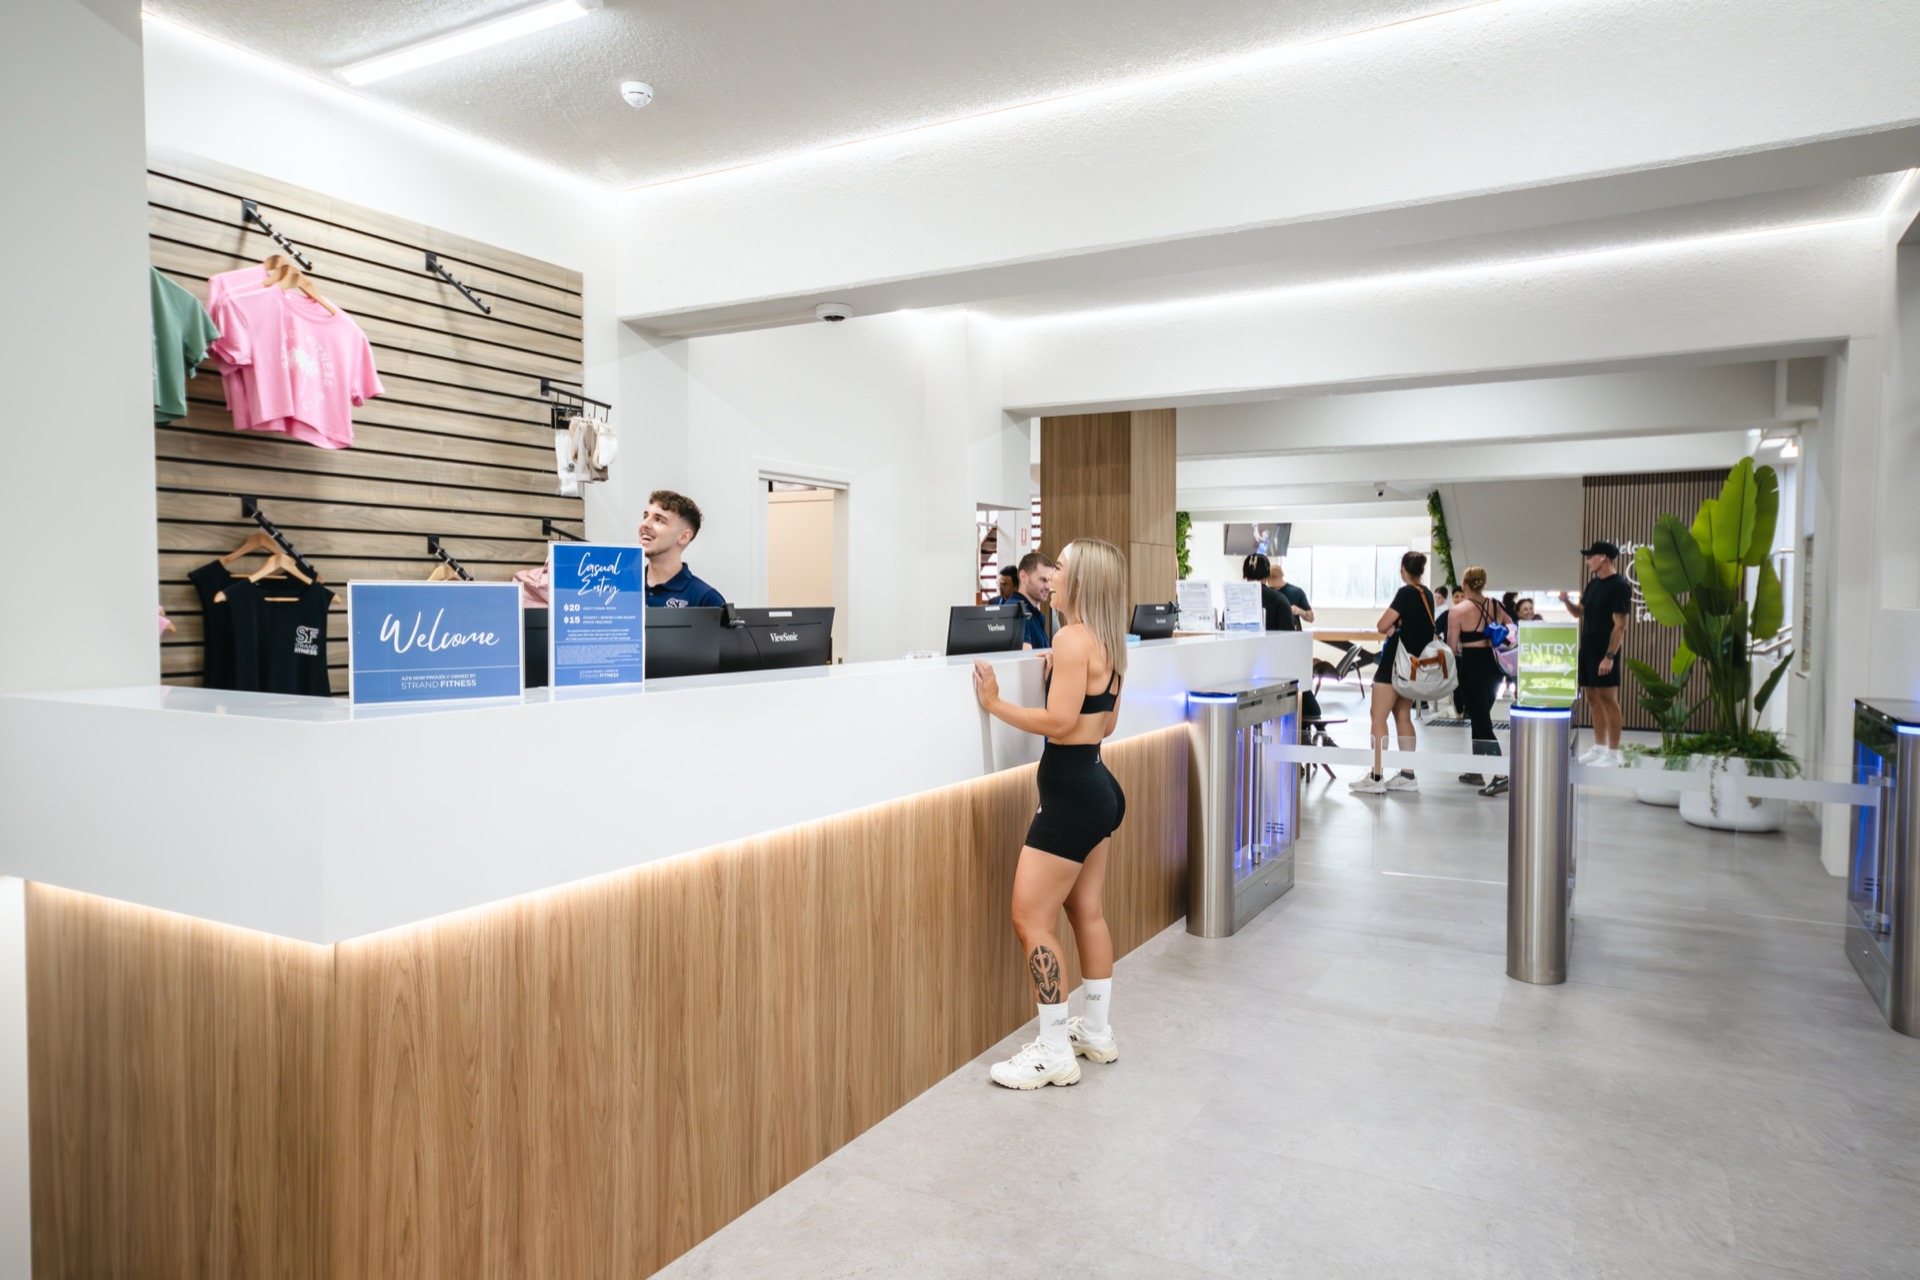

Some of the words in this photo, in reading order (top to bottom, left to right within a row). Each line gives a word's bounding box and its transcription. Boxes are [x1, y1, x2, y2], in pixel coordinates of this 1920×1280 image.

[578, 552, 622, 577] Casual
[578, 573, 620, 605] Entry
[563, 603, 581, 612] $20
[563, 616, 581, 624] $15
[380, 608, 500, 653] Welcome
[770, 632, 798, 642] ViewSonic
[1520, 643, 1576, 655] ENTRY
[401, 681, 439, 690] STRAND
[440, 679, 477, 688] FITNESS
[1034, 1064, 1045, 1072] N
